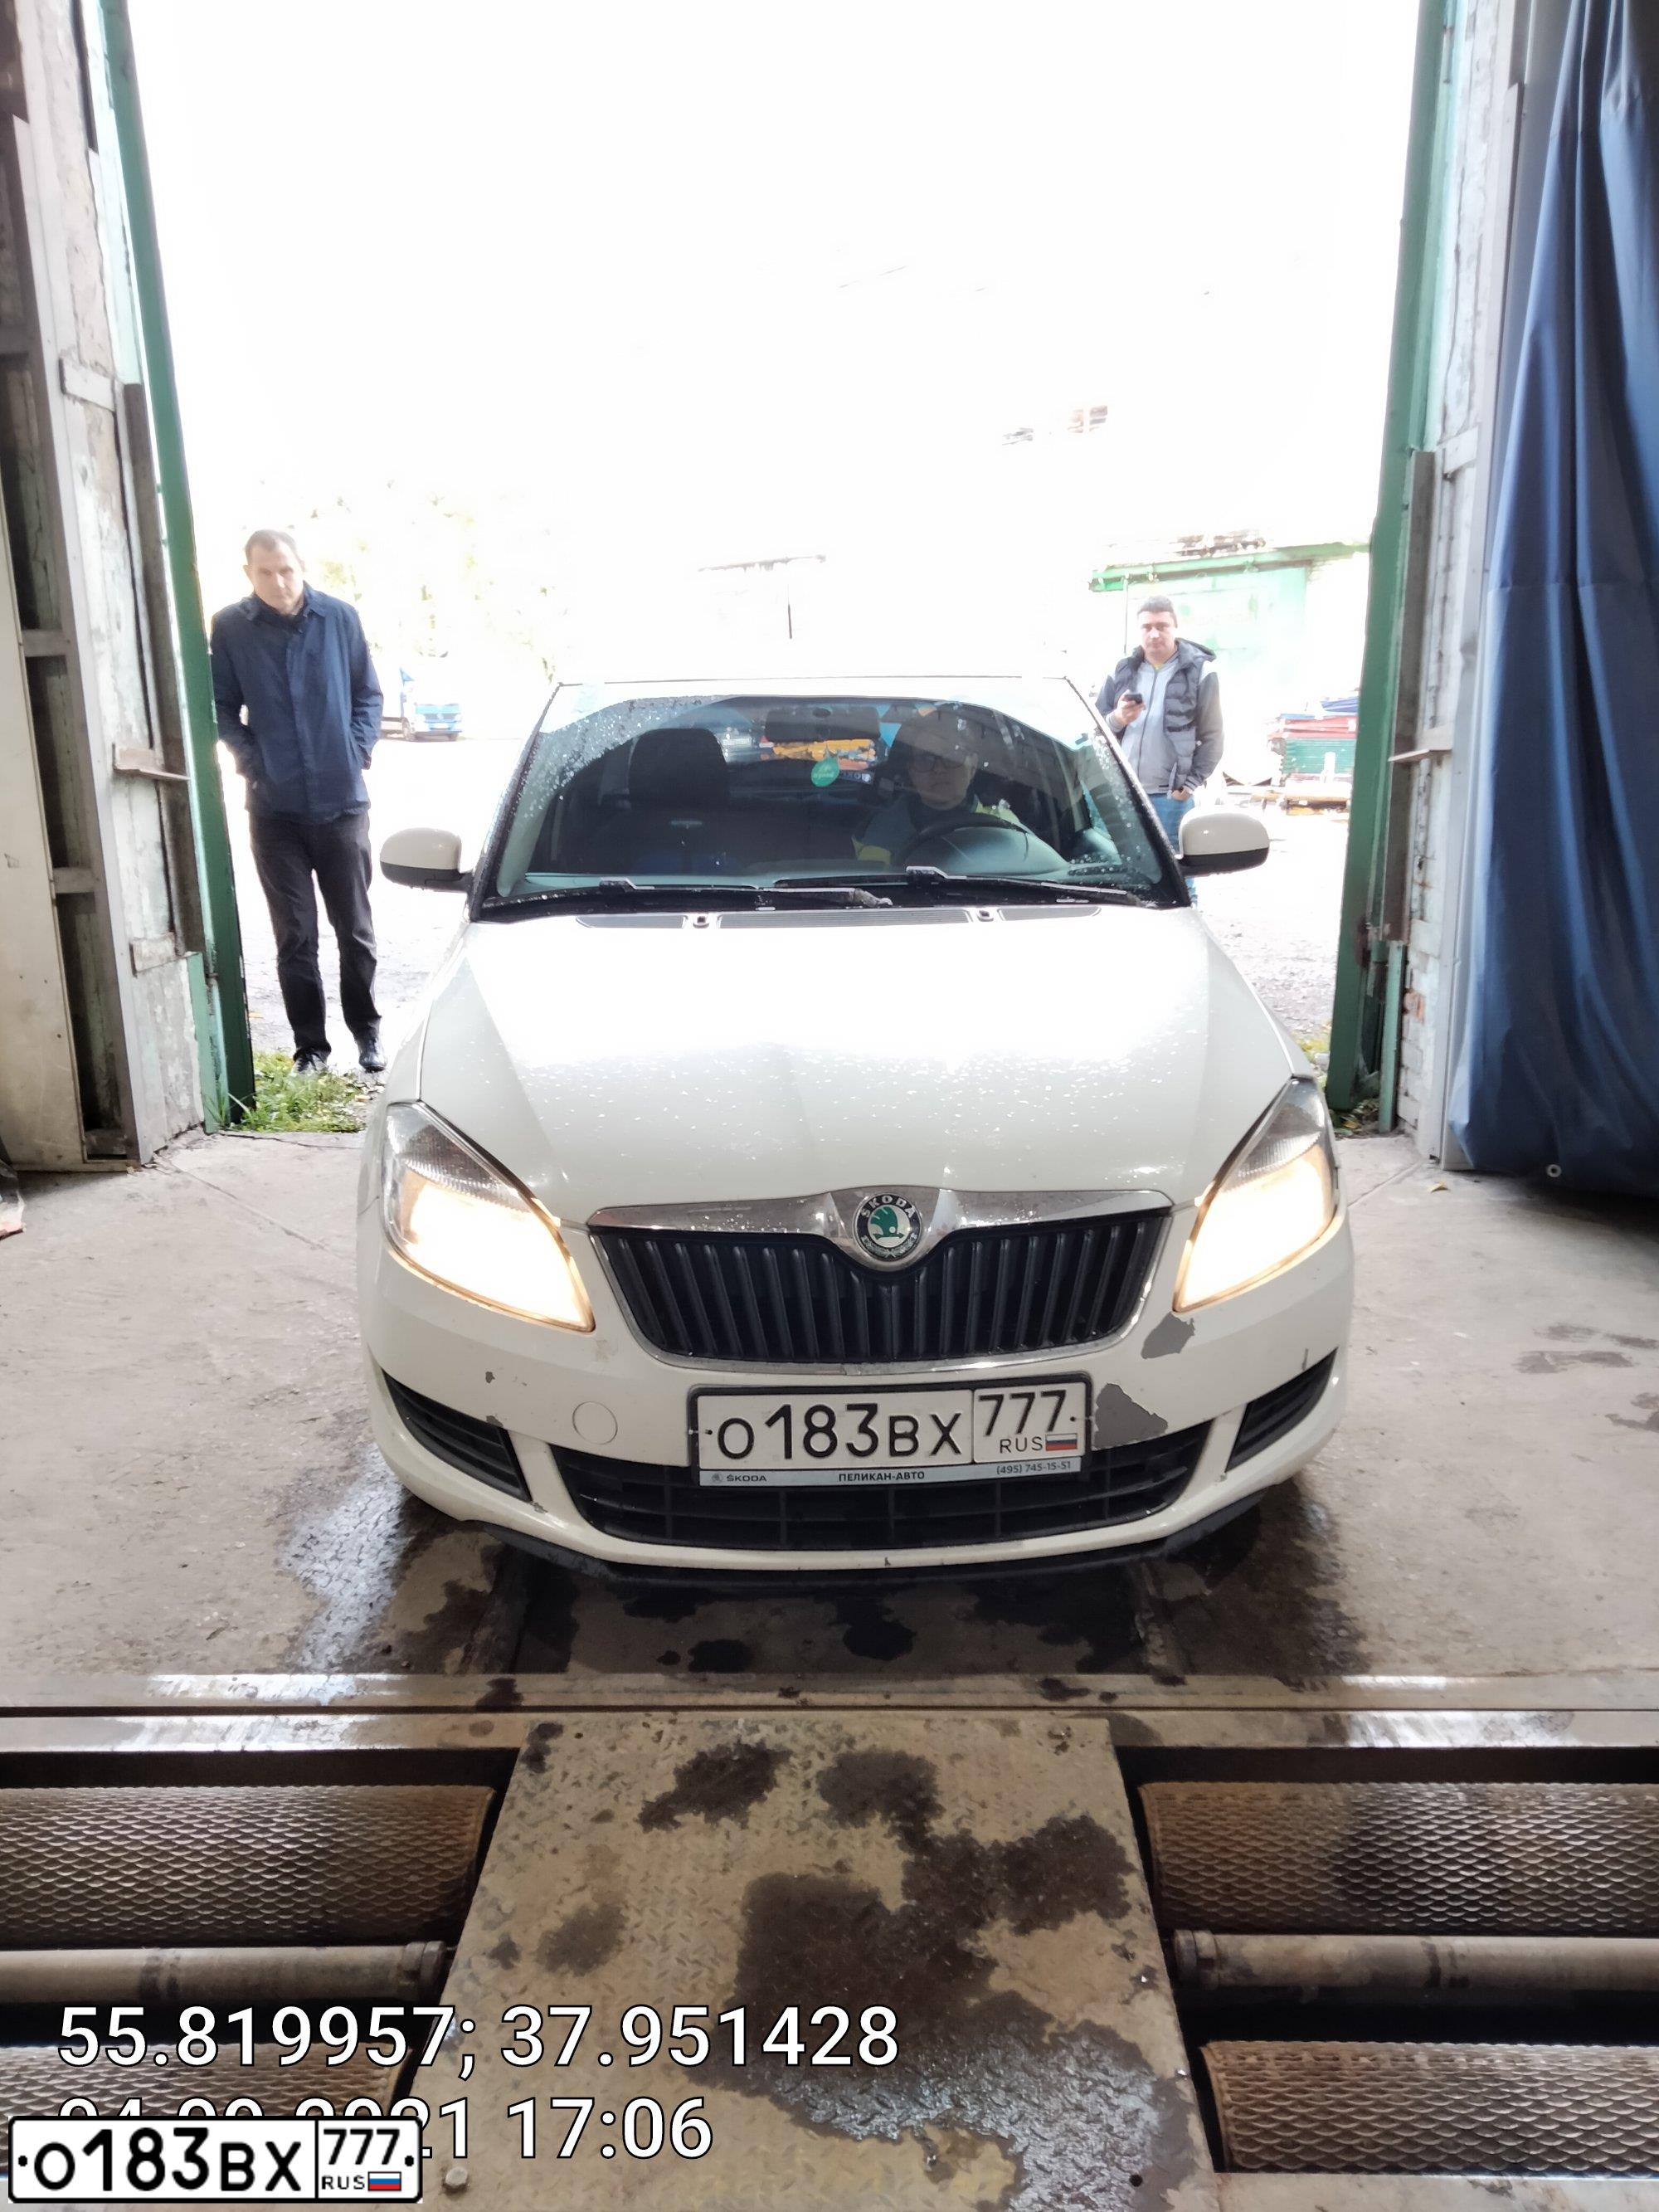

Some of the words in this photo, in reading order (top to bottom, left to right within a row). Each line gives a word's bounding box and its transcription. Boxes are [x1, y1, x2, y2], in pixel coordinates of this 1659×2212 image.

[978, 1389, 1067, 1437] 777
[999, 1436, 1044, 1454] RUS
[996, 1464, 1023, 1475] (495)
[1024, 1461, 1071, 1473] 745-15-51
[839, 1471, 925, 1483] ПЕЛИКАН-АВТО
